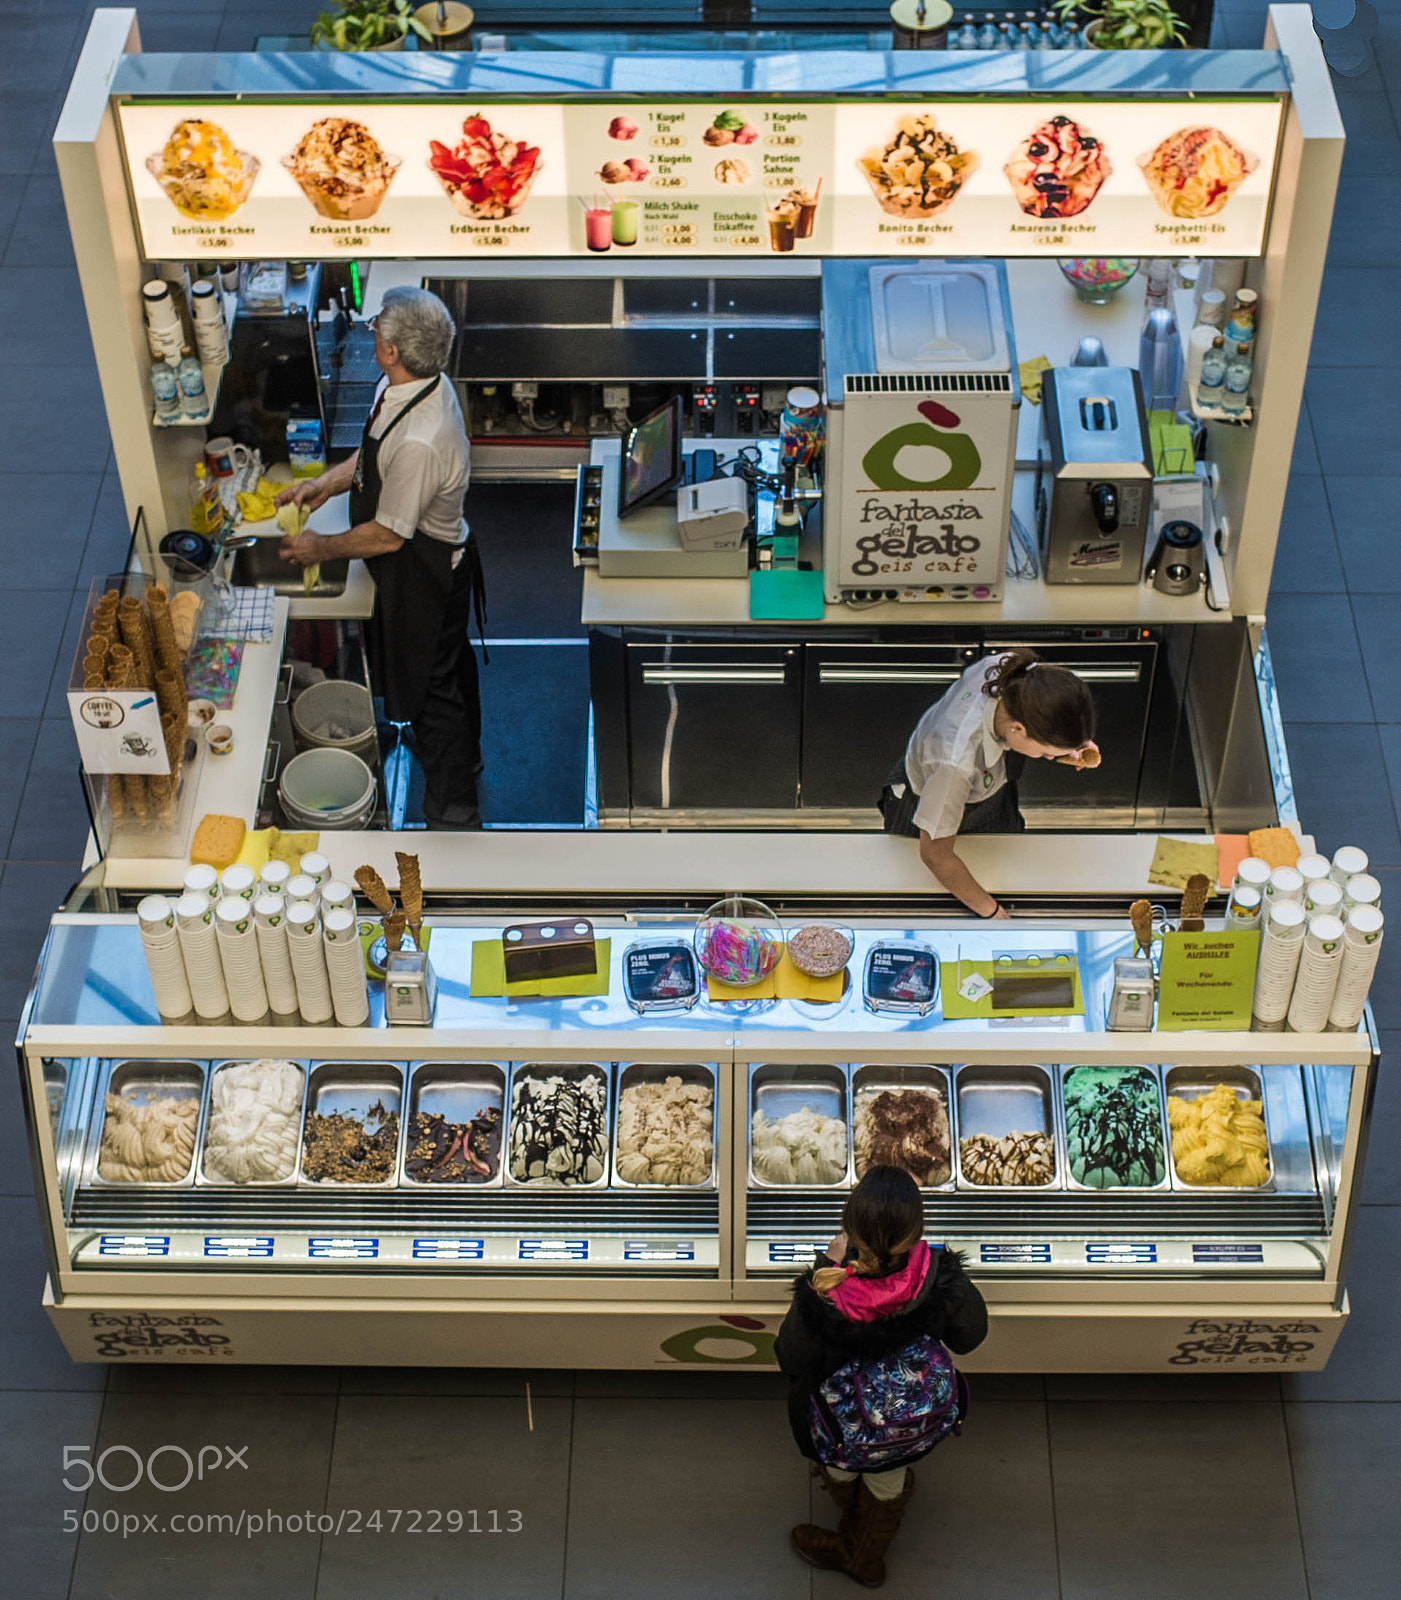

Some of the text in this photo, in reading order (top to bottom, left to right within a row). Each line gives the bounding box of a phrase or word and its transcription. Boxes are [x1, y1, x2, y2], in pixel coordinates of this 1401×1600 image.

[649, 113, 685, 123] 1 Kugel
[773, 112, 807, 123] Kugeln
[658, 124, 671, 132] Eis
[773, 123, 786, 132] Eis
[649, 154, 692, 165] 2 Kugeln
[764, 154, 801, 163] Portion
[659, 165, 672, 174] Eis
[764, 165, 794, 173] Sahne
[644, 202, 699, 210] Milch Shake
[714, 212, 757, 221] Eisschoko
[220, 226, 255, 234] Becher
[310, 226, 391, 234] Krokant Becher
[450, 225, 530, 233] Erdbeer Becher
[714, 223, 755, 231] Eiskaffee
[879, 224, 953, 232] Bonito Becher
[1010, 224, 1096, 232] Amarena Becher
[860, 498, 983, 522] fantasia
[881, 523, 906, 537] del
[852, 524, 981, 576] gelato
[881, 557, 978, 573] eis cafè
[1187, 951, 1230, 959] AUSHILFE
[89, 1312, 223, 1327] fantasia
[1185, 1319, 1322, 1335] fantasia
[94, 1327, 231, 1357] gelato
[1168, 1335, 1315, 1366] gelato
